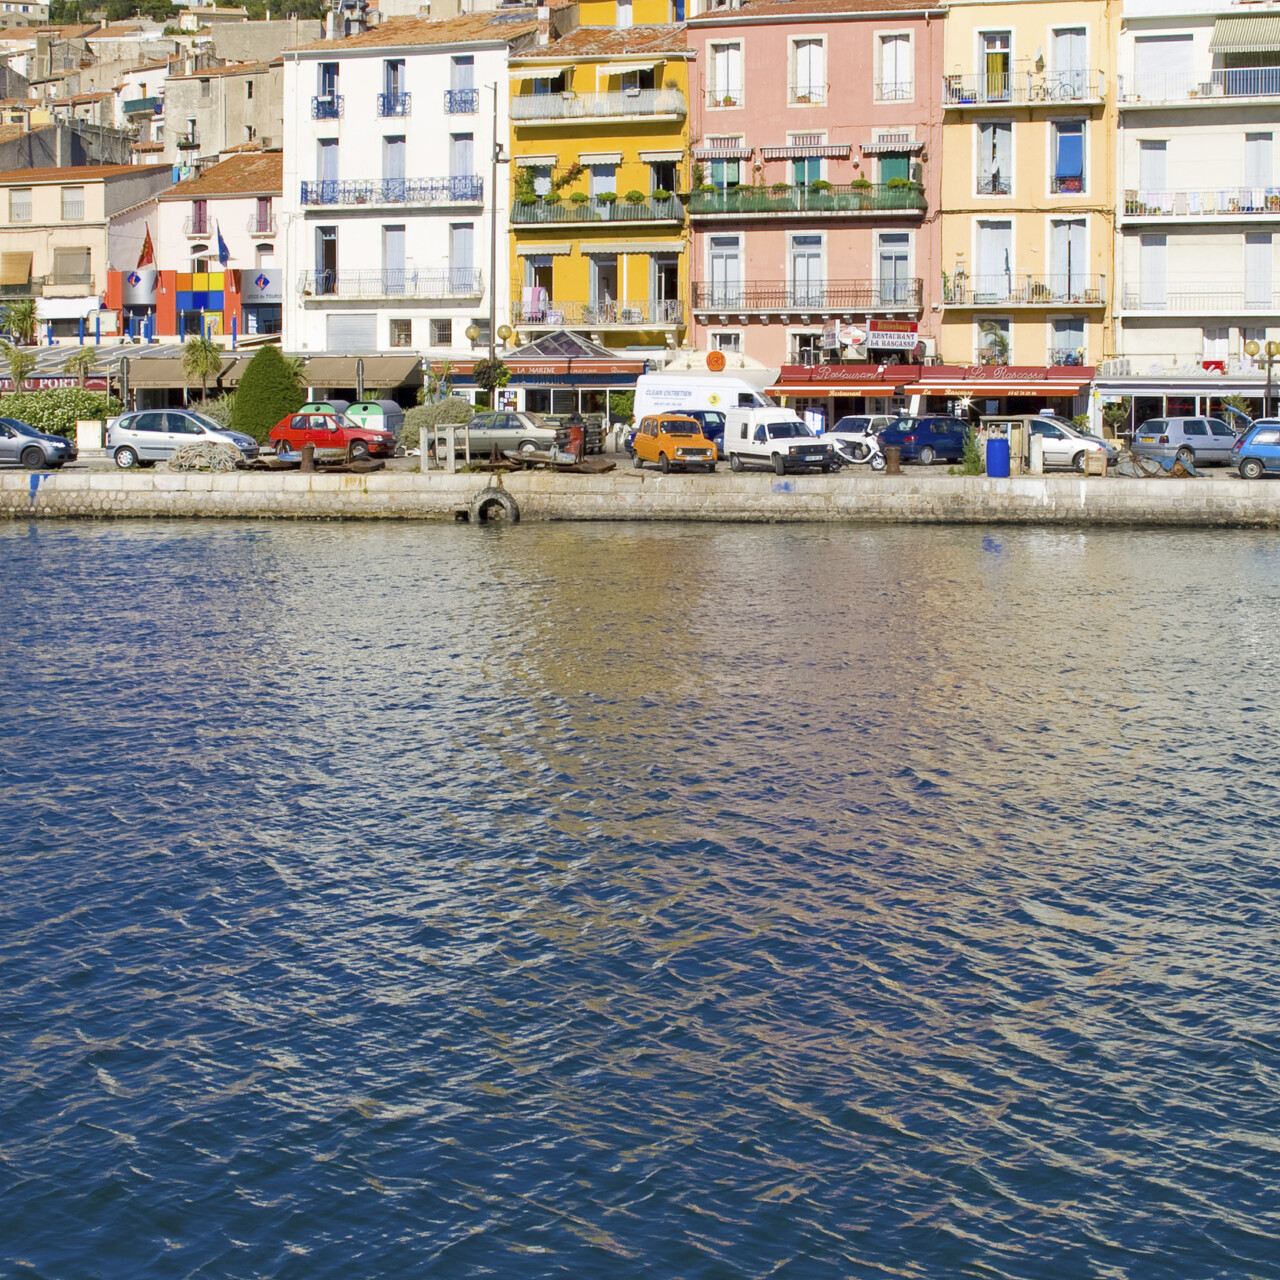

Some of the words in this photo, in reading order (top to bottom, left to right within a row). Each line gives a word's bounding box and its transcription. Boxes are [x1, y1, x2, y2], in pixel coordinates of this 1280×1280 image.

[529, 366, 556, 374] MARINE
[817, 366, 882, 380] Restaurant
[970, 366, 986, 380] La
[994, 366, 1045, 380] Rascasse
[39, 377, 78, 389] PORT
[829, 389, 862, 397] Restaurant
